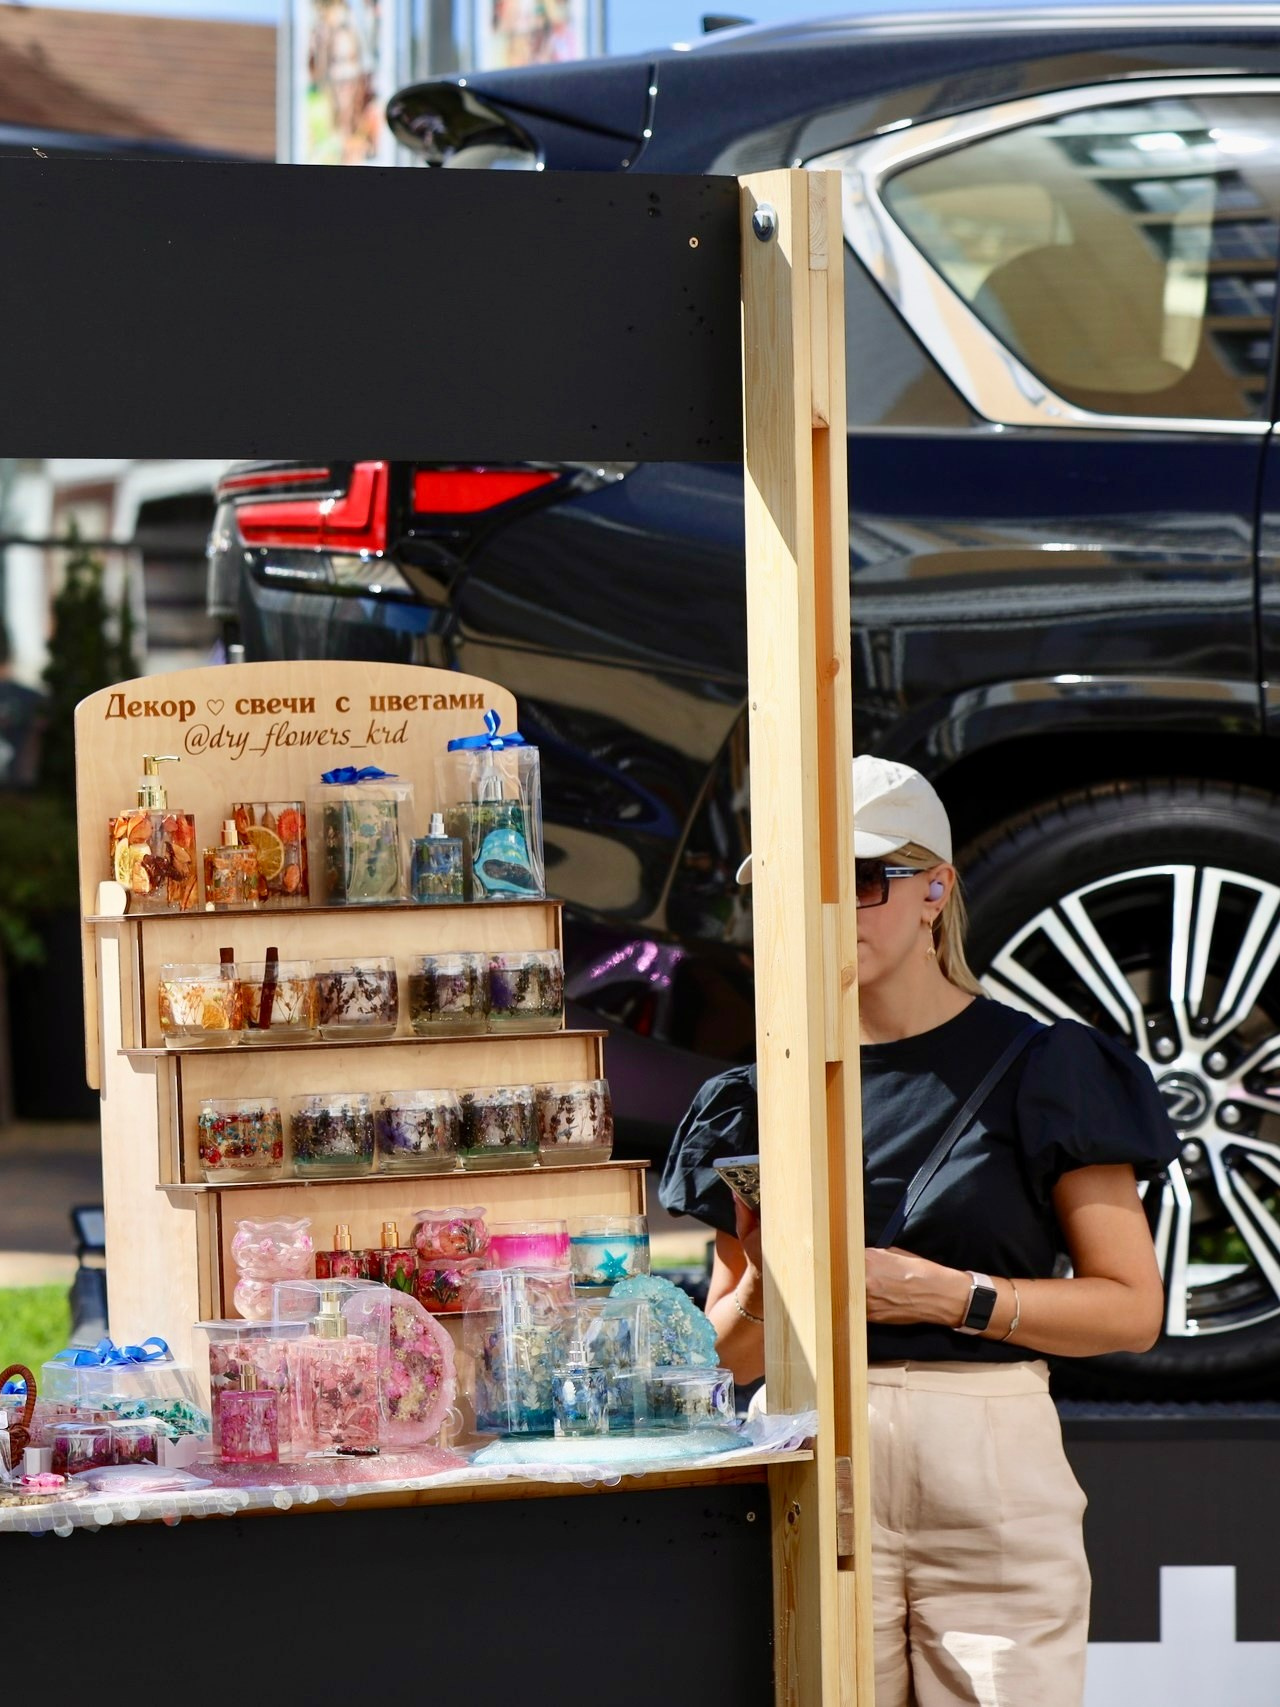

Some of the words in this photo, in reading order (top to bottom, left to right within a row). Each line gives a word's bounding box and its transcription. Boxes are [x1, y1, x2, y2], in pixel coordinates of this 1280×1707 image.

[104, 693, 197, 723] Декор
[234, 696, 317, 717] свечи
[335, 695, 352, 713] с
[369, 692, 486, 714] цветами
[183, 718, 410, 762] @dry_flowers_krd
